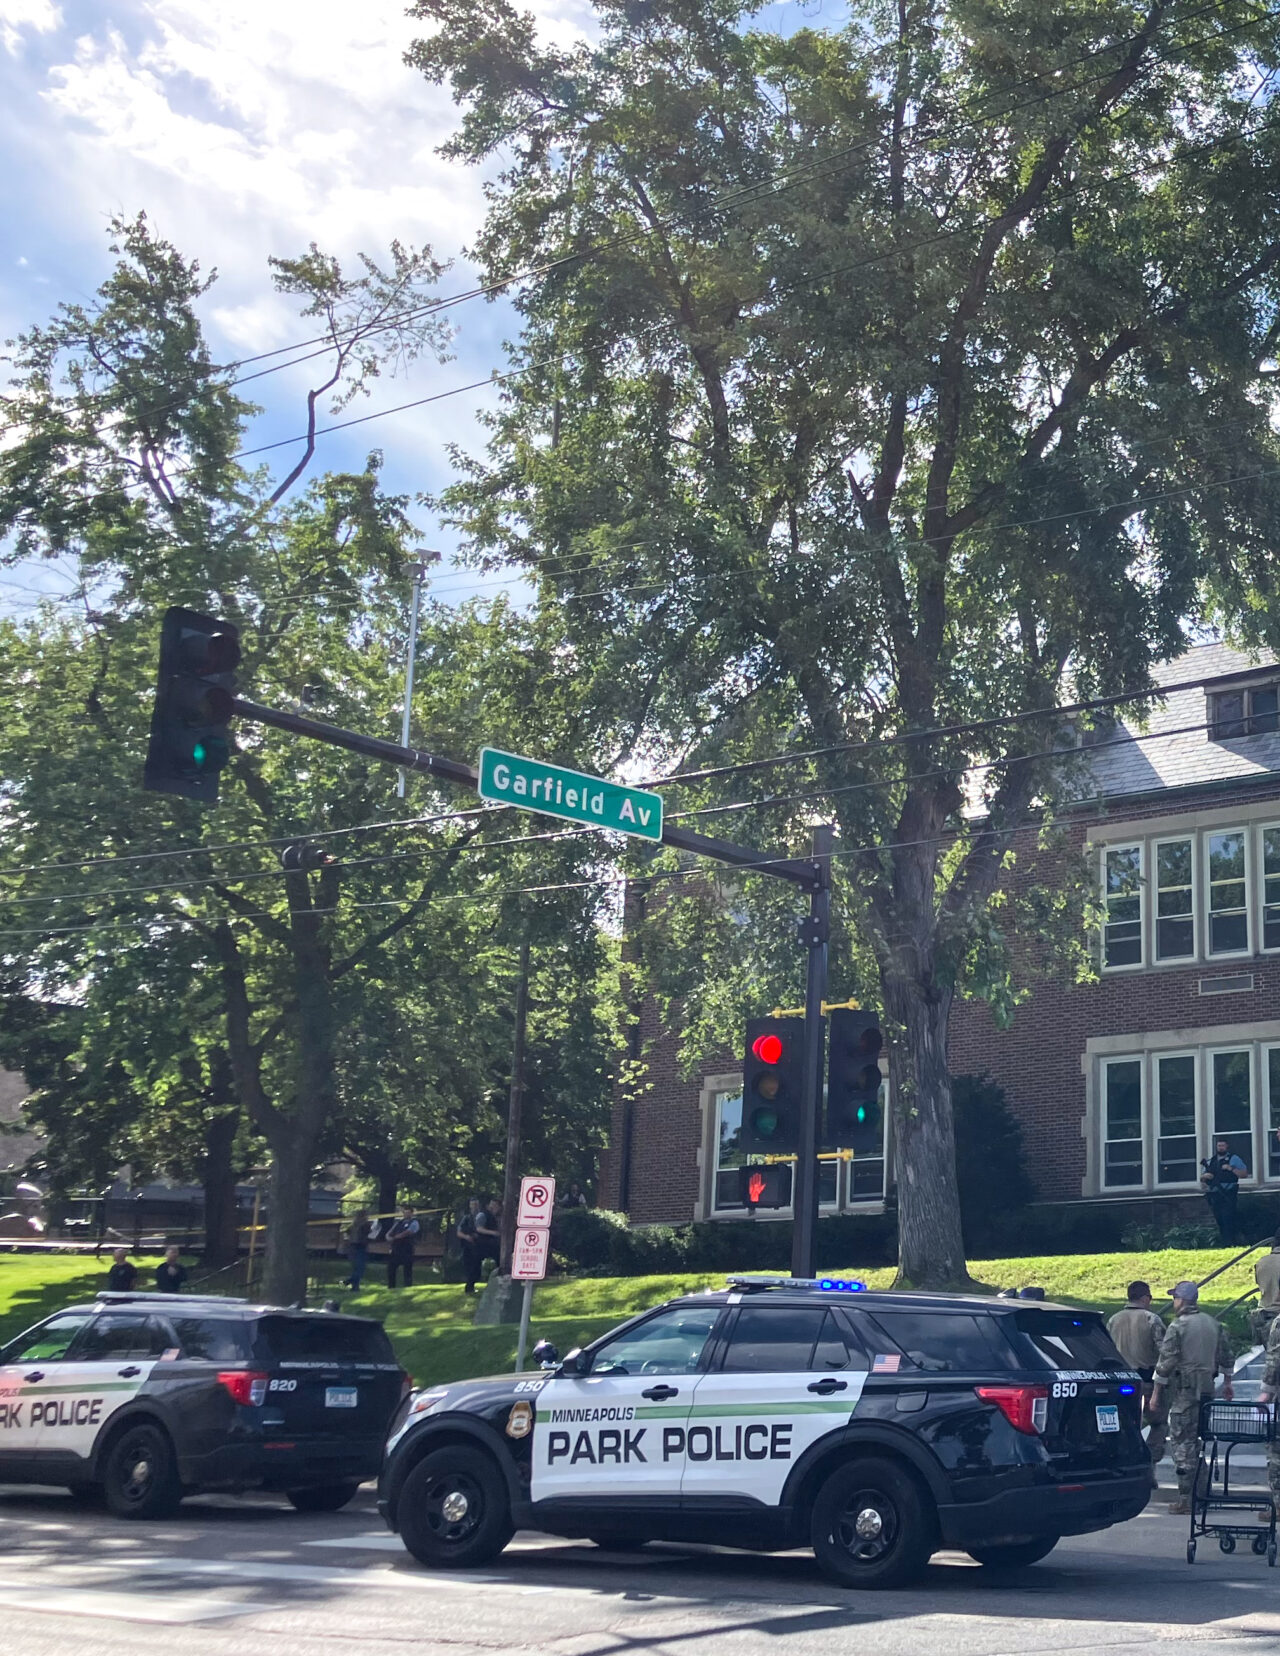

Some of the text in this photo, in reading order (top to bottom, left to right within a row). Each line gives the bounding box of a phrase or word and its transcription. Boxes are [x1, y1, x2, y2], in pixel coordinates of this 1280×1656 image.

[493, 764, 651, 826] Garfield Av
[269, 1379, 298, 1391] 820
[513, 1380, 545, 1393] 850
[1052, 1382, 1078, 1398] 850
[30, 1399, 104, 1428] POLICE
[551, 1407, 634, 1423] MINNEAPOLIS
[547, 1423, 793, 1466] PARK POLICE
